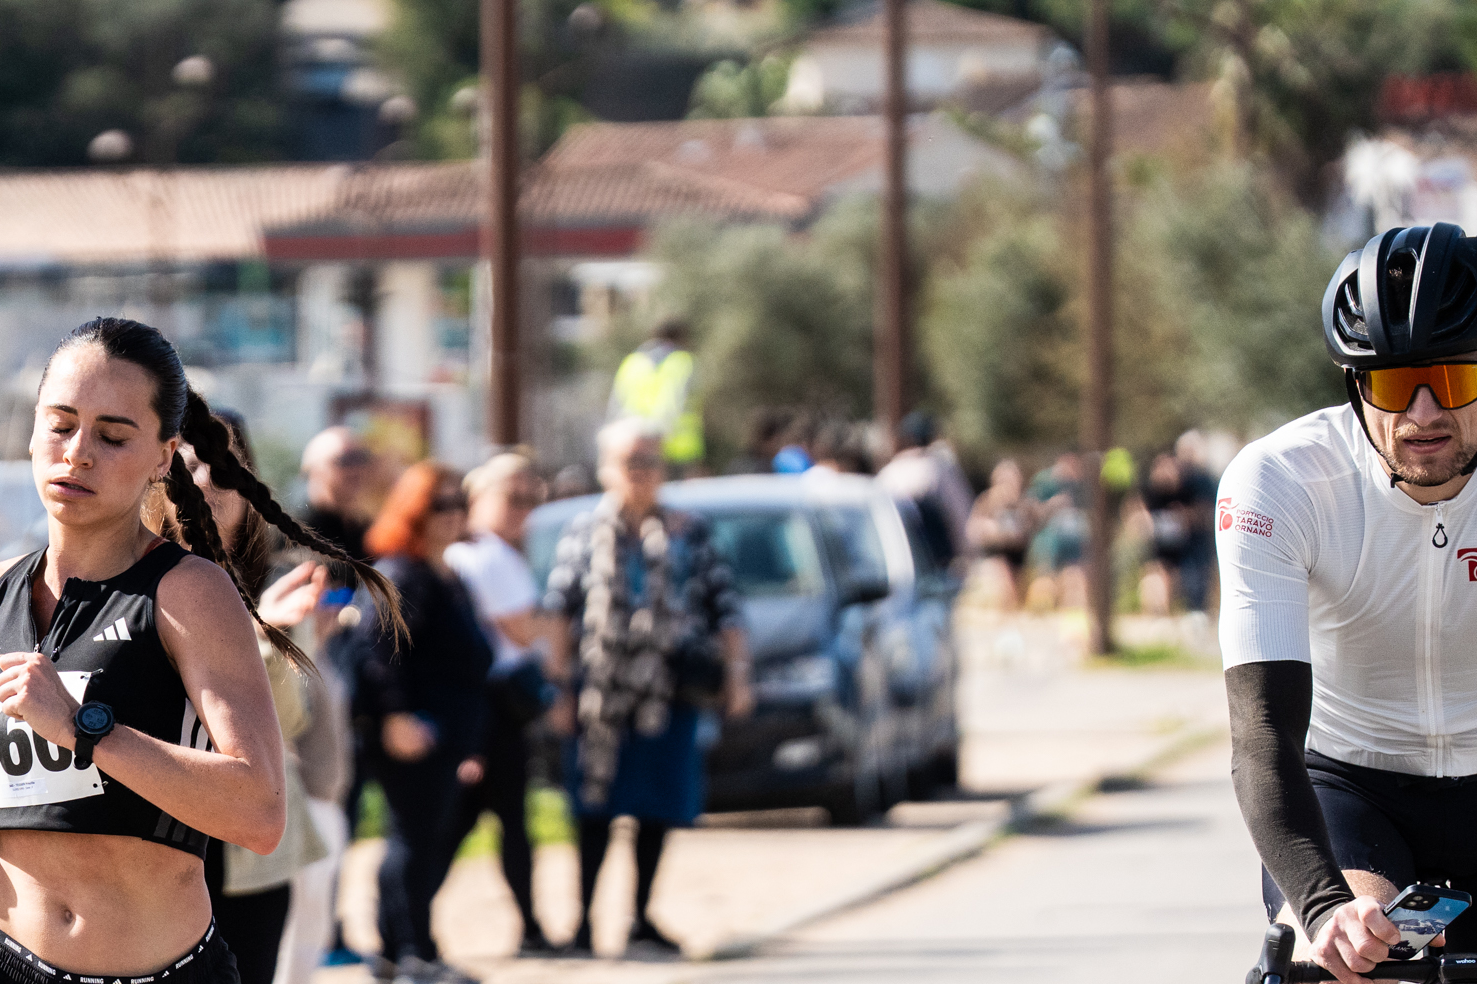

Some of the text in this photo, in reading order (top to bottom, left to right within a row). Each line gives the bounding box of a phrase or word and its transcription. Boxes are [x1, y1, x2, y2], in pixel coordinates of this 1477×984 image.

[1236, 510, 1274, 524] PORTICCIO
[1236, 516, 1273, 531] TARAVO
[1235, 525, 1272, 537] ORNANO
[80, 976, 104, 984] RUNNING
[130, 976, 155, 984] RUNNING
[175, 953, 194, 969] RUNNING
